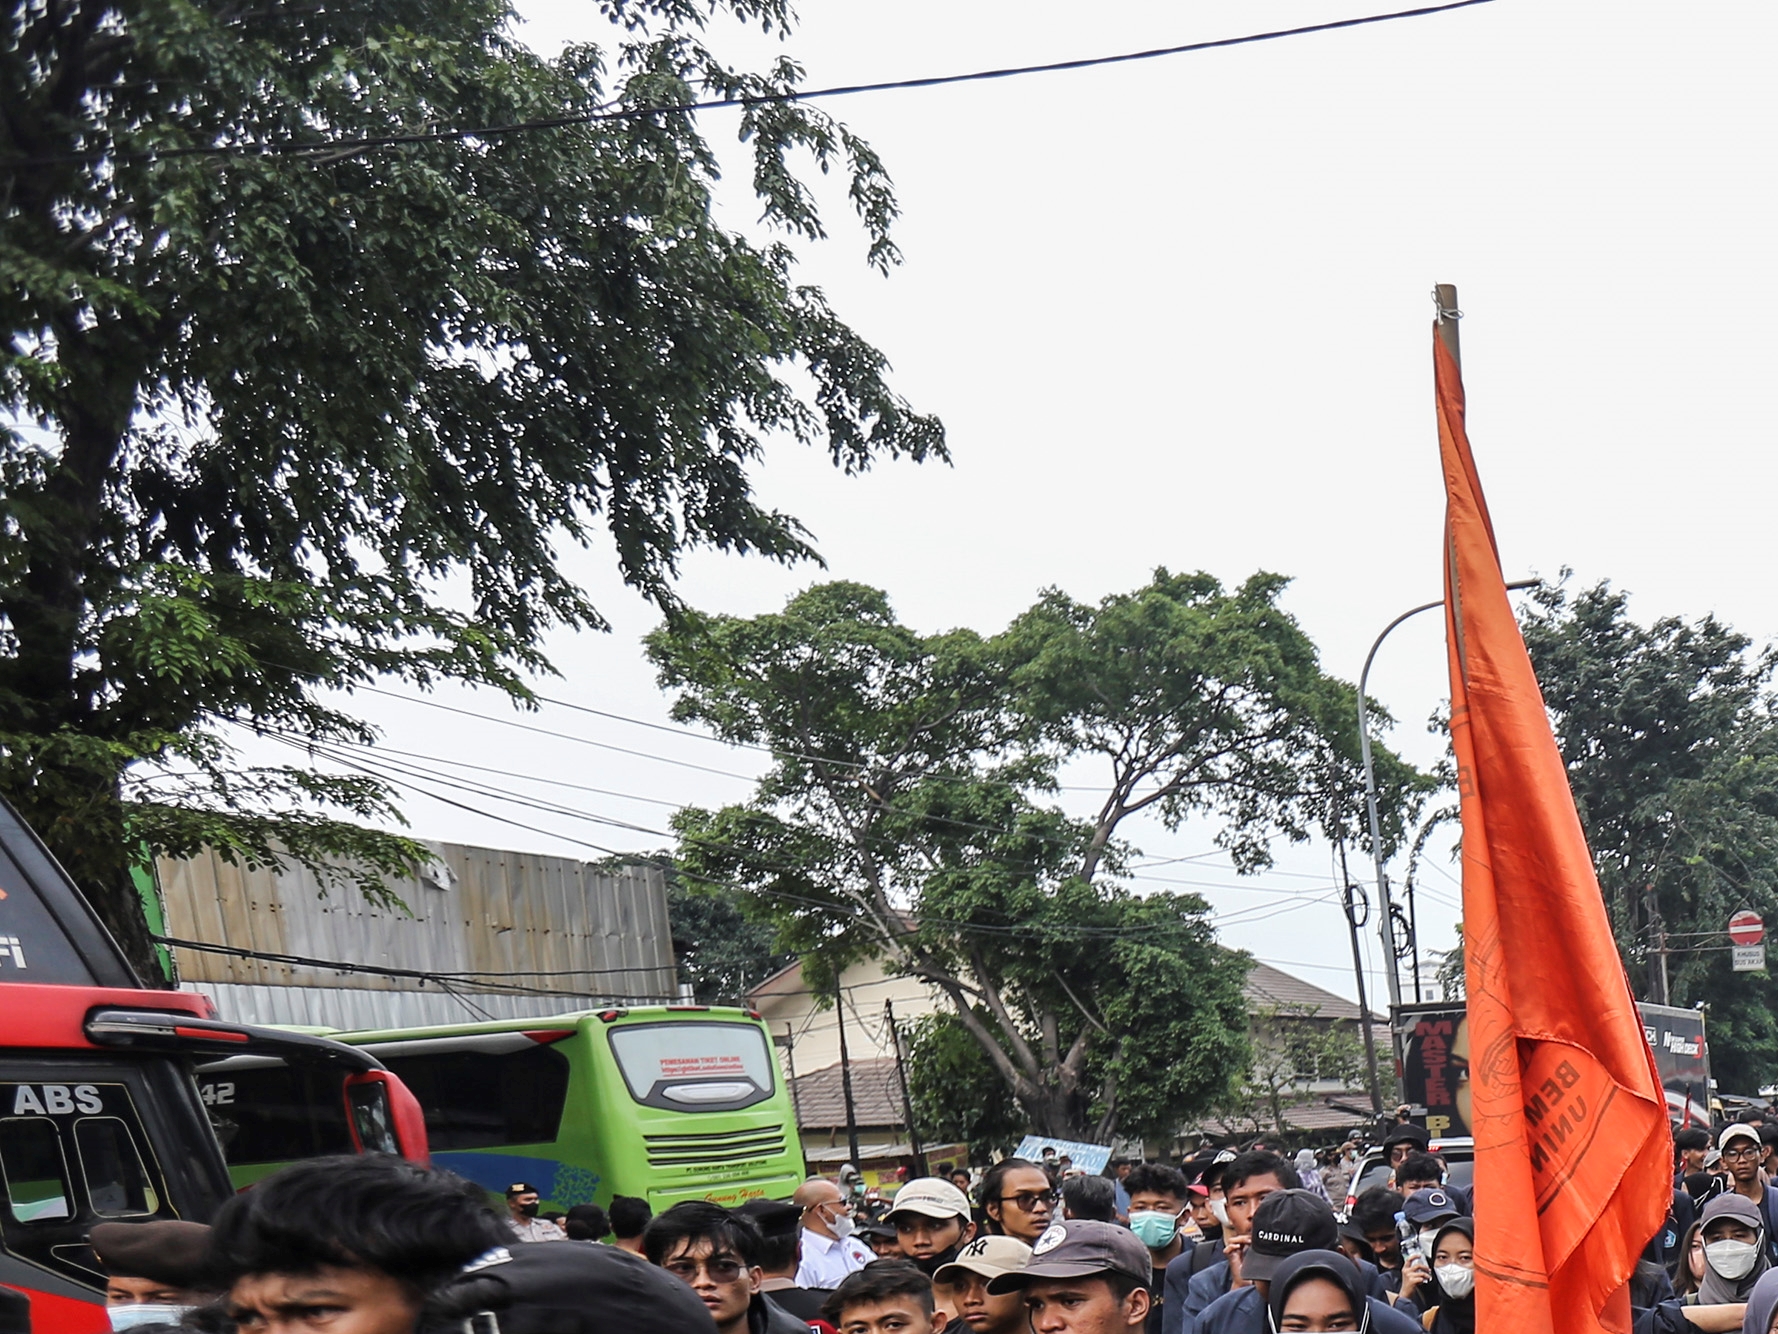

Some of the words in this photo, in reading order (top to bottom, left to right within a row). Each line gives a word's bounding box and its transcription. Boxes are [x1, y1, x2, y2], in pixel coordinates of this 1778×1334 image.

[1415, 1021, 1452, 1106] MASTER
[14, 1084, 103, 1115] ABS
[1258, 1230, 1304, 1243] CARDINAL
